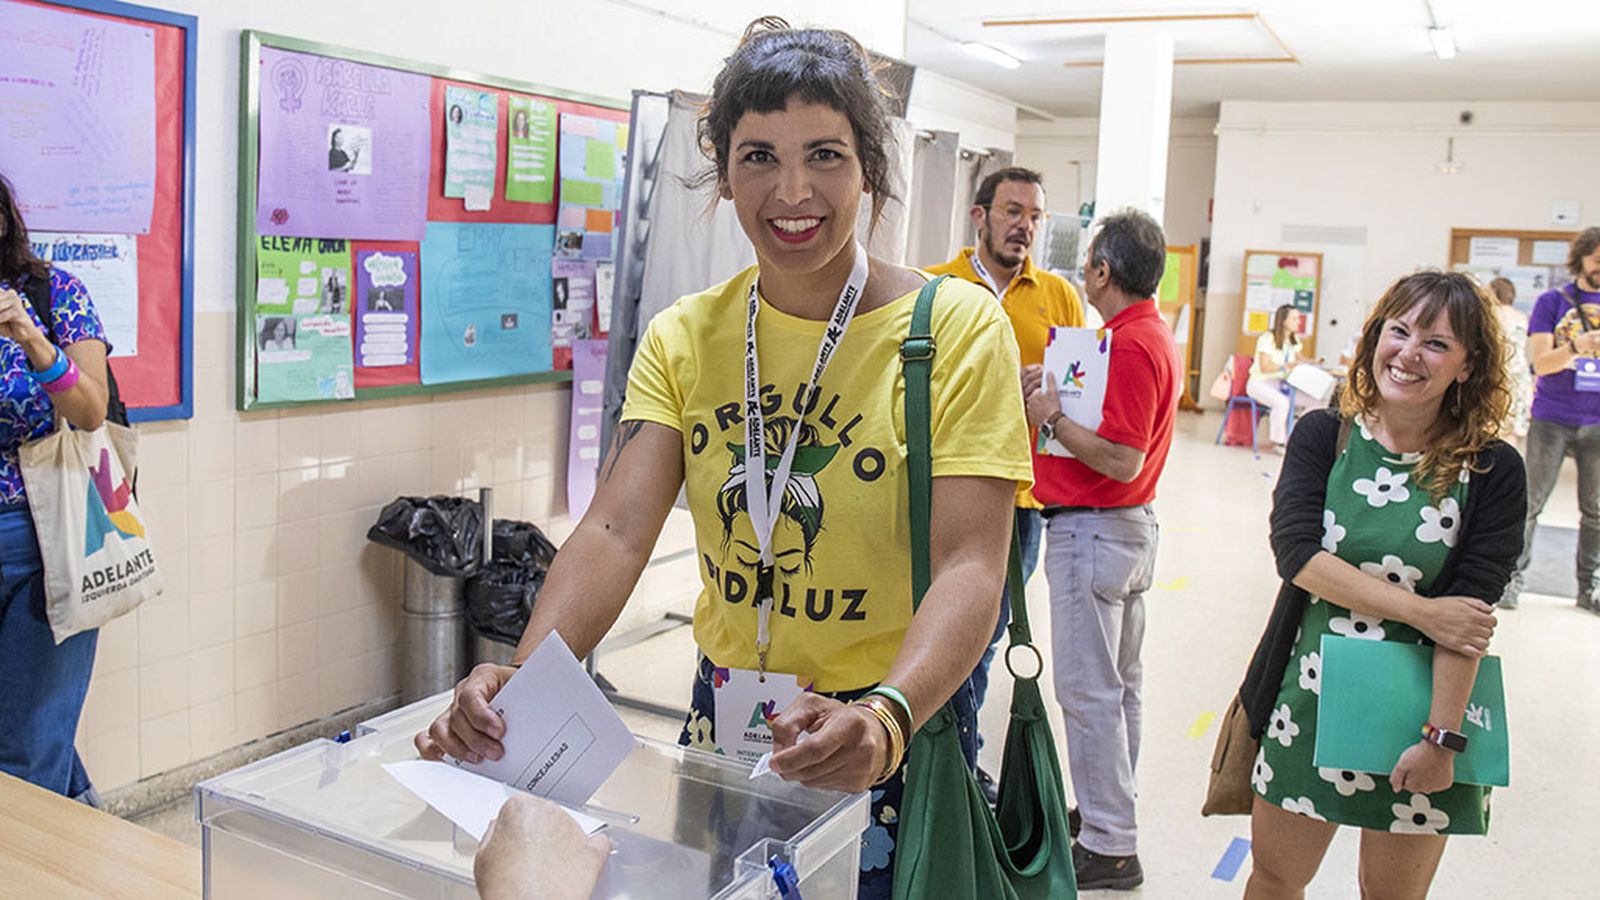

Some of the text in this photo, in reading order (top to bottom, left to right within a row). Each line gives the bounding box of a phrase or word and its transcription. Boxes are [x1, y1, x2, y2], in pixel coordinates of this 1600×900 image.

[691, 382, 886, 482] ORGULLO
[81, 548, 154, 593] ADELANTE
[81, 582, 127, 604] IZQUIERDA
